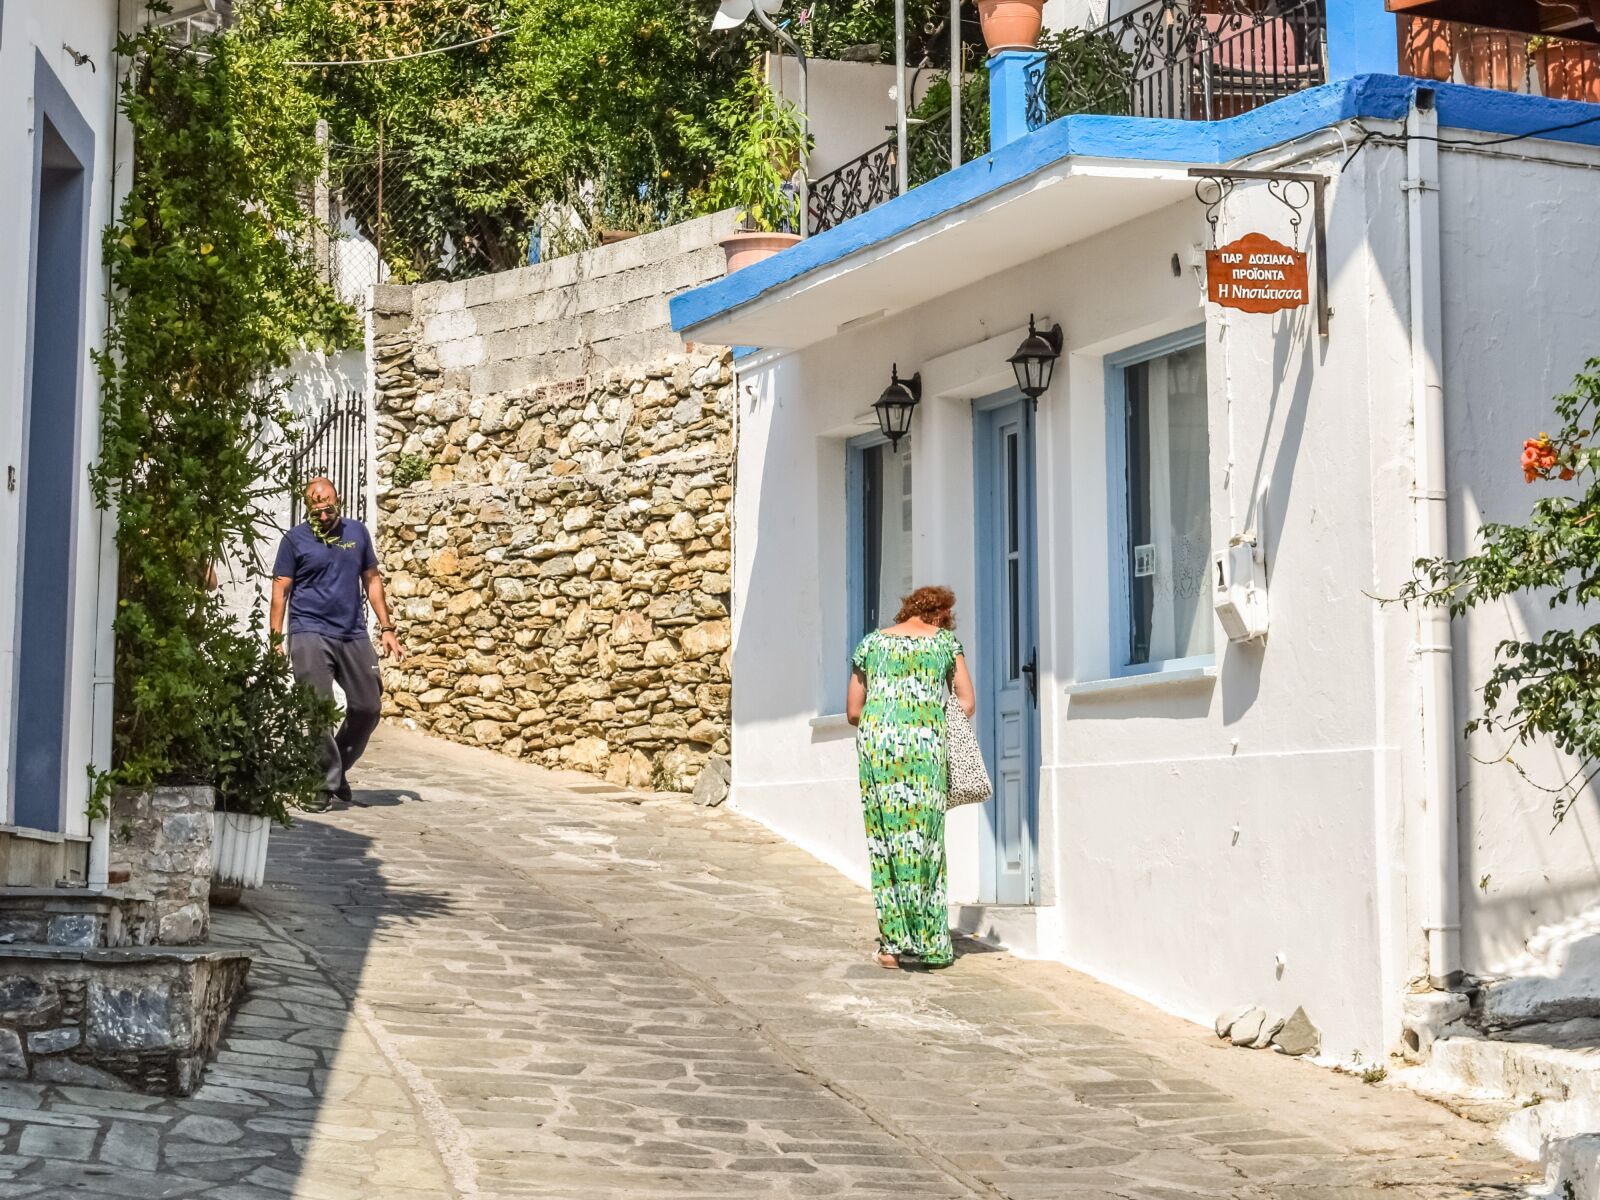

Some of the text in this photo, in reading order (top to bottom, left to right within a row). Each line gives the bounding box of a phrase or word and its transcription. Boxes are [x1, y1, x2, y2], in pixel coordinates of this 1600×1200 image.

[1232, 268, 1286, 280] ΠΡΟΪΟΝΤΑ
[1218, 284, 1303, 300] Η Νησιώτισσα
